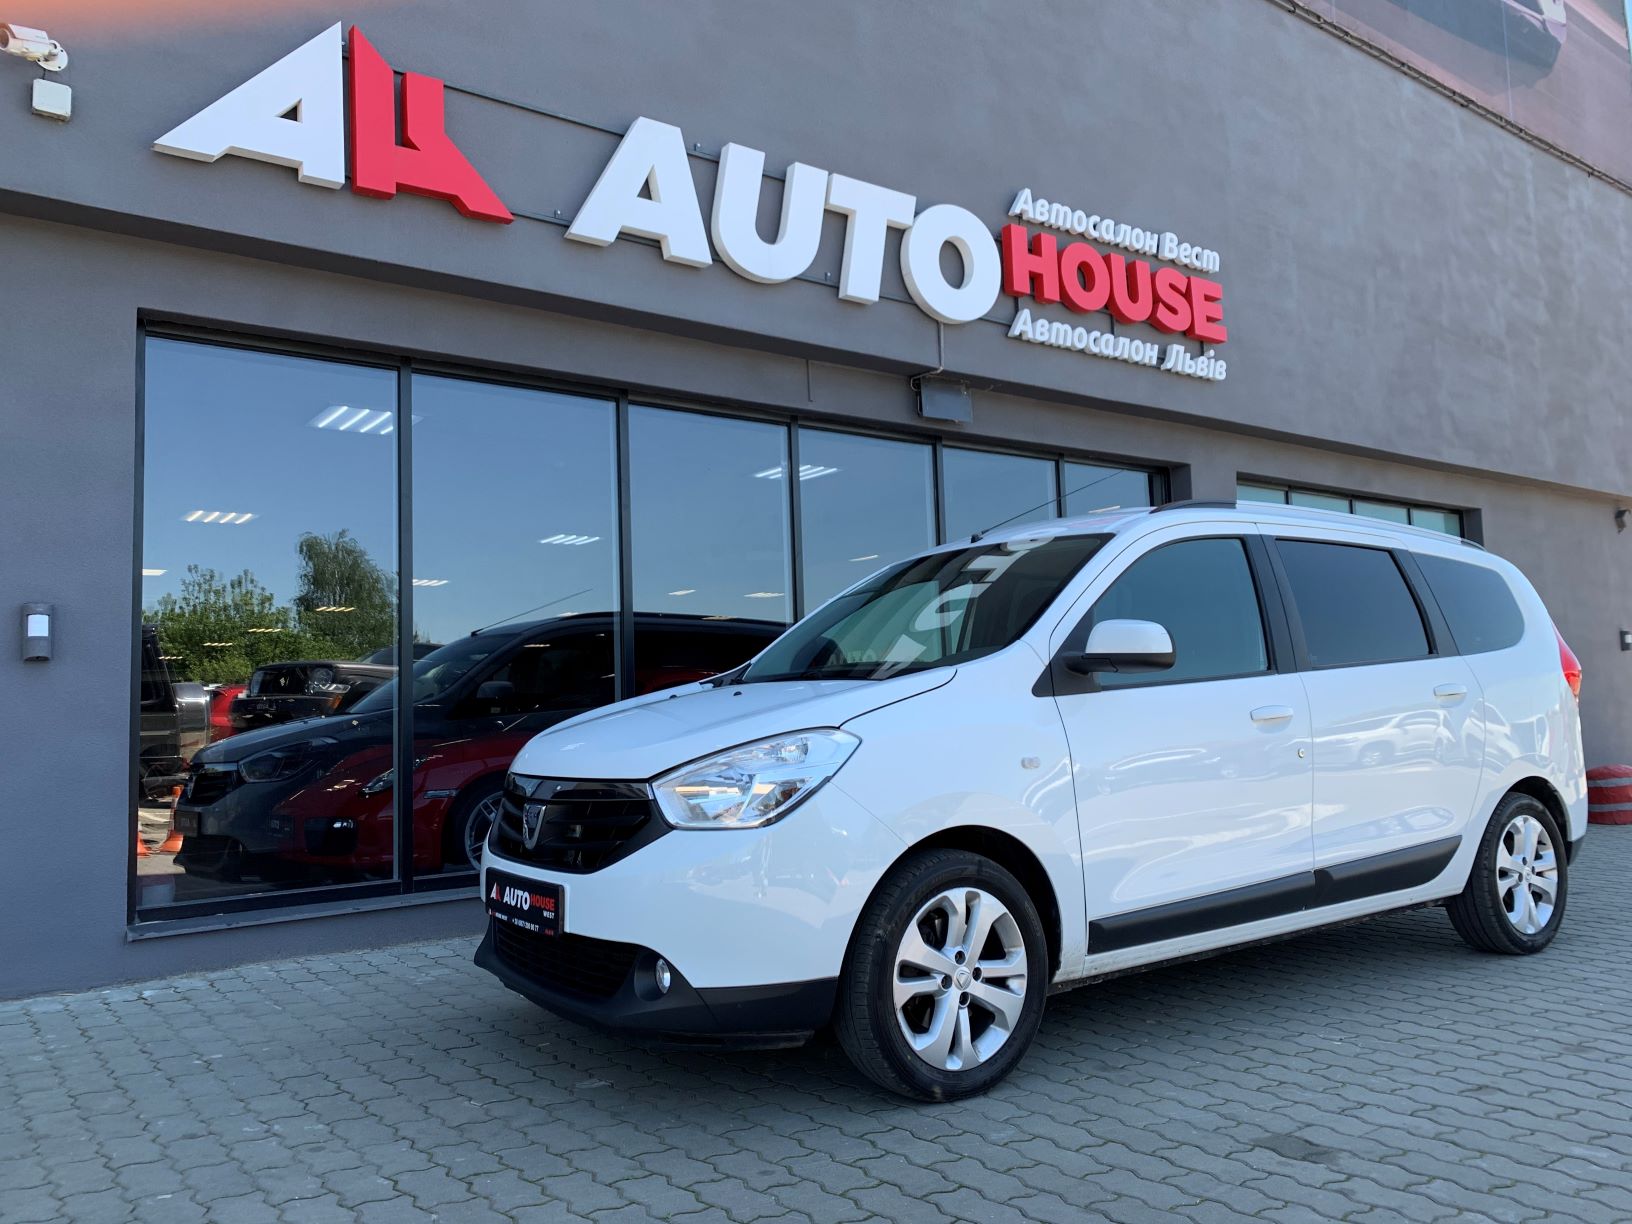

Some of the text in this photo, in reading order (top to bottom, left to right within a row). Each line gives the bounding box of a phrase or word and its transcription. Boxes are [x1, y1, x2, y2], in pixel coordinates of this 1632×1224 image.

[564, 116, 1002, 325] AUTO
[1001, 223, 1228, 344] HOUSE
[1008, 187, 1220, 273] Автосалон Вест
[1007, 308, 1228, 381] Автосалон Львів
[503, 886, 530, 910] AUTO
[530, 894, 555, 910] HOUSE
[543, 911, 554, 919] WEST
